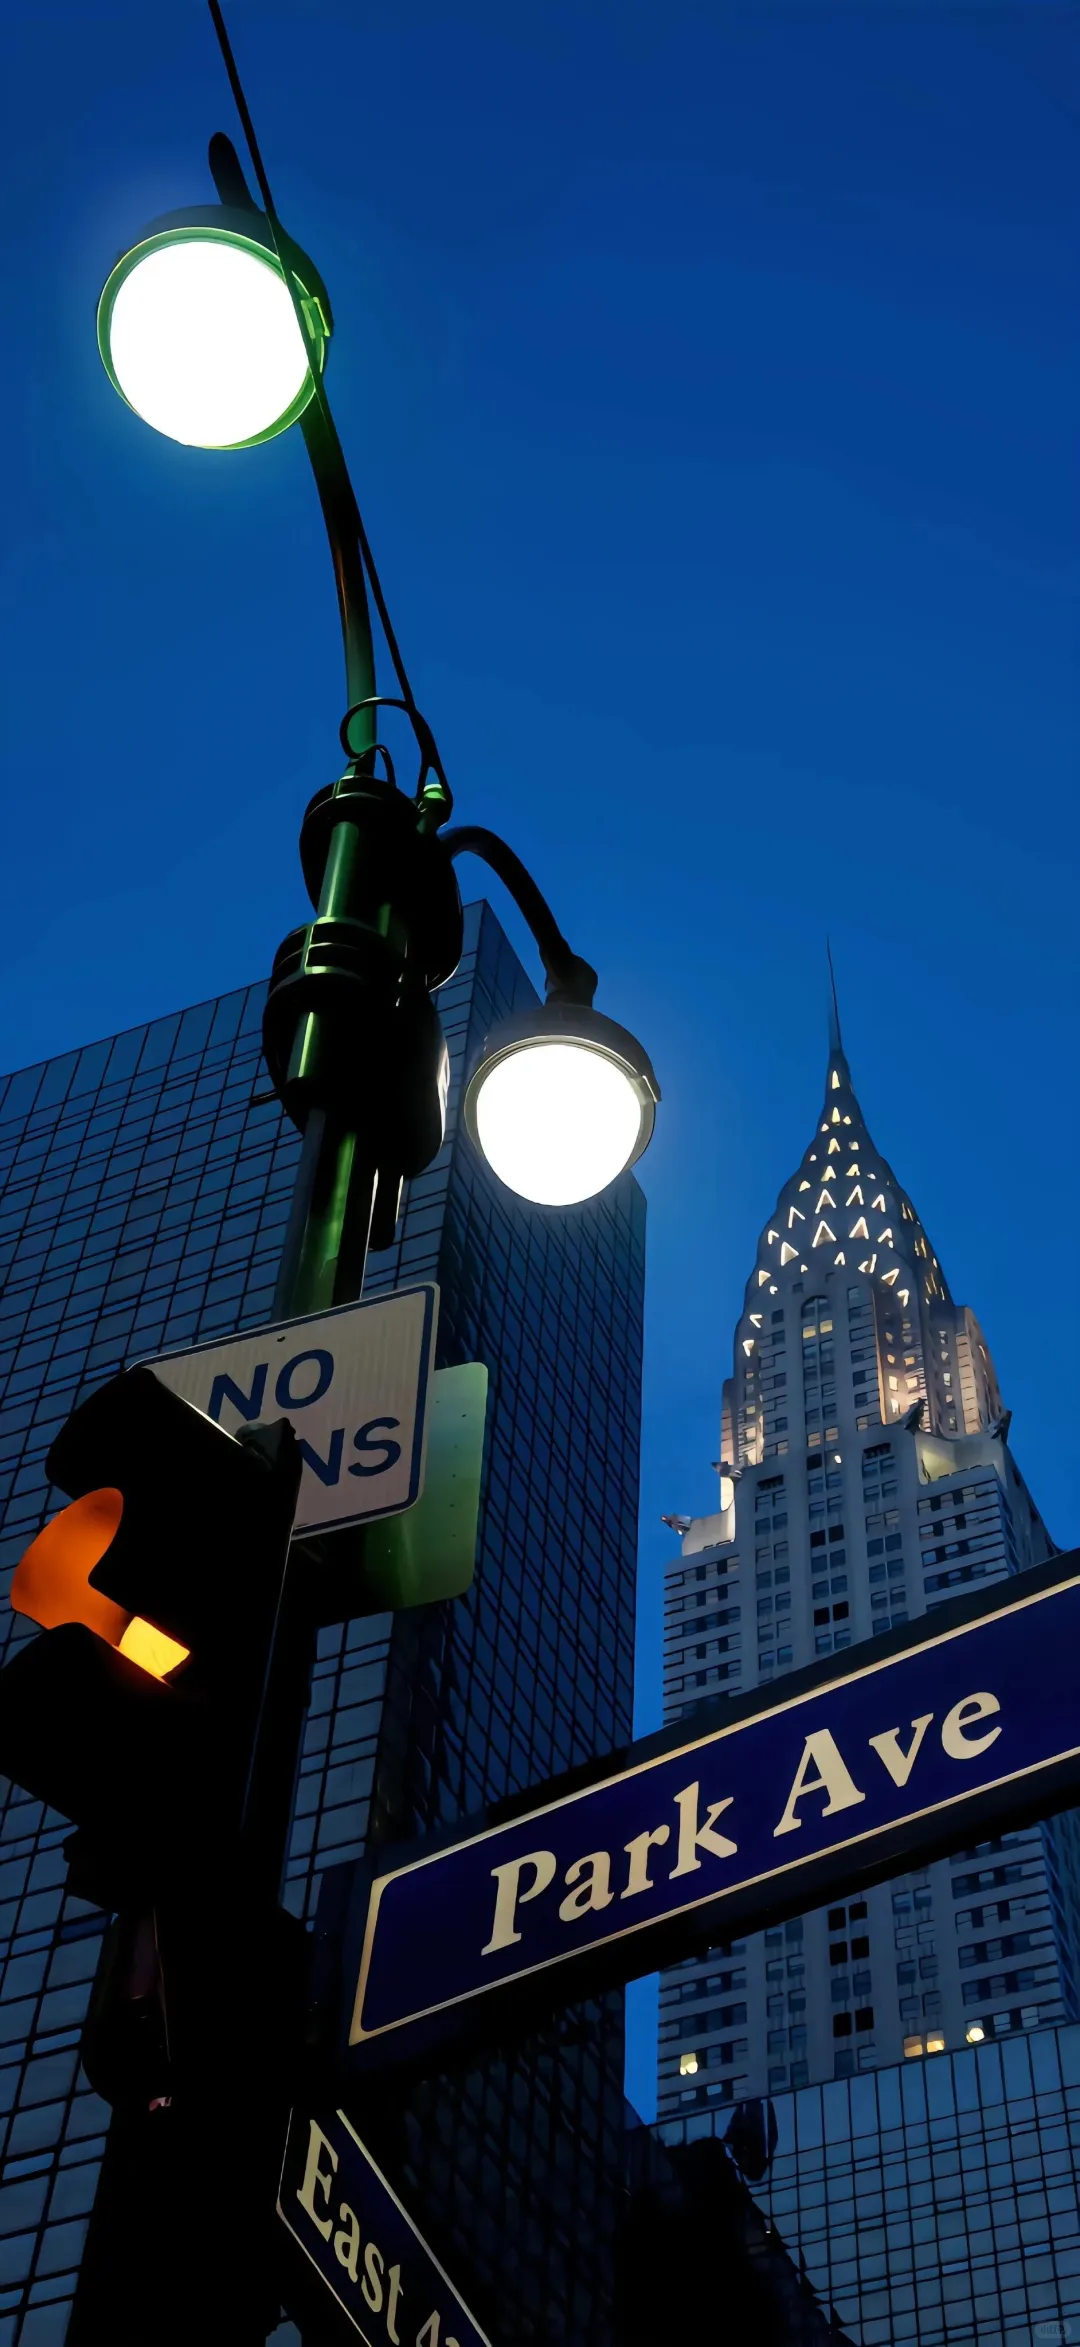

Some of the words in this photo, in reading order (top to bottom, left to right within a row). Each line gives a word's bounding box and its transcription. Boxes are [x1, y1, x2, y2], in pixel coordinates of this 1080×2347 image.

[207, 1348, 335, 1422] NO
[480, 1780, 738, 1956] Park
[773, 1691, 1003, 1838] Ave
[296, 2119, 404, 2346] East
